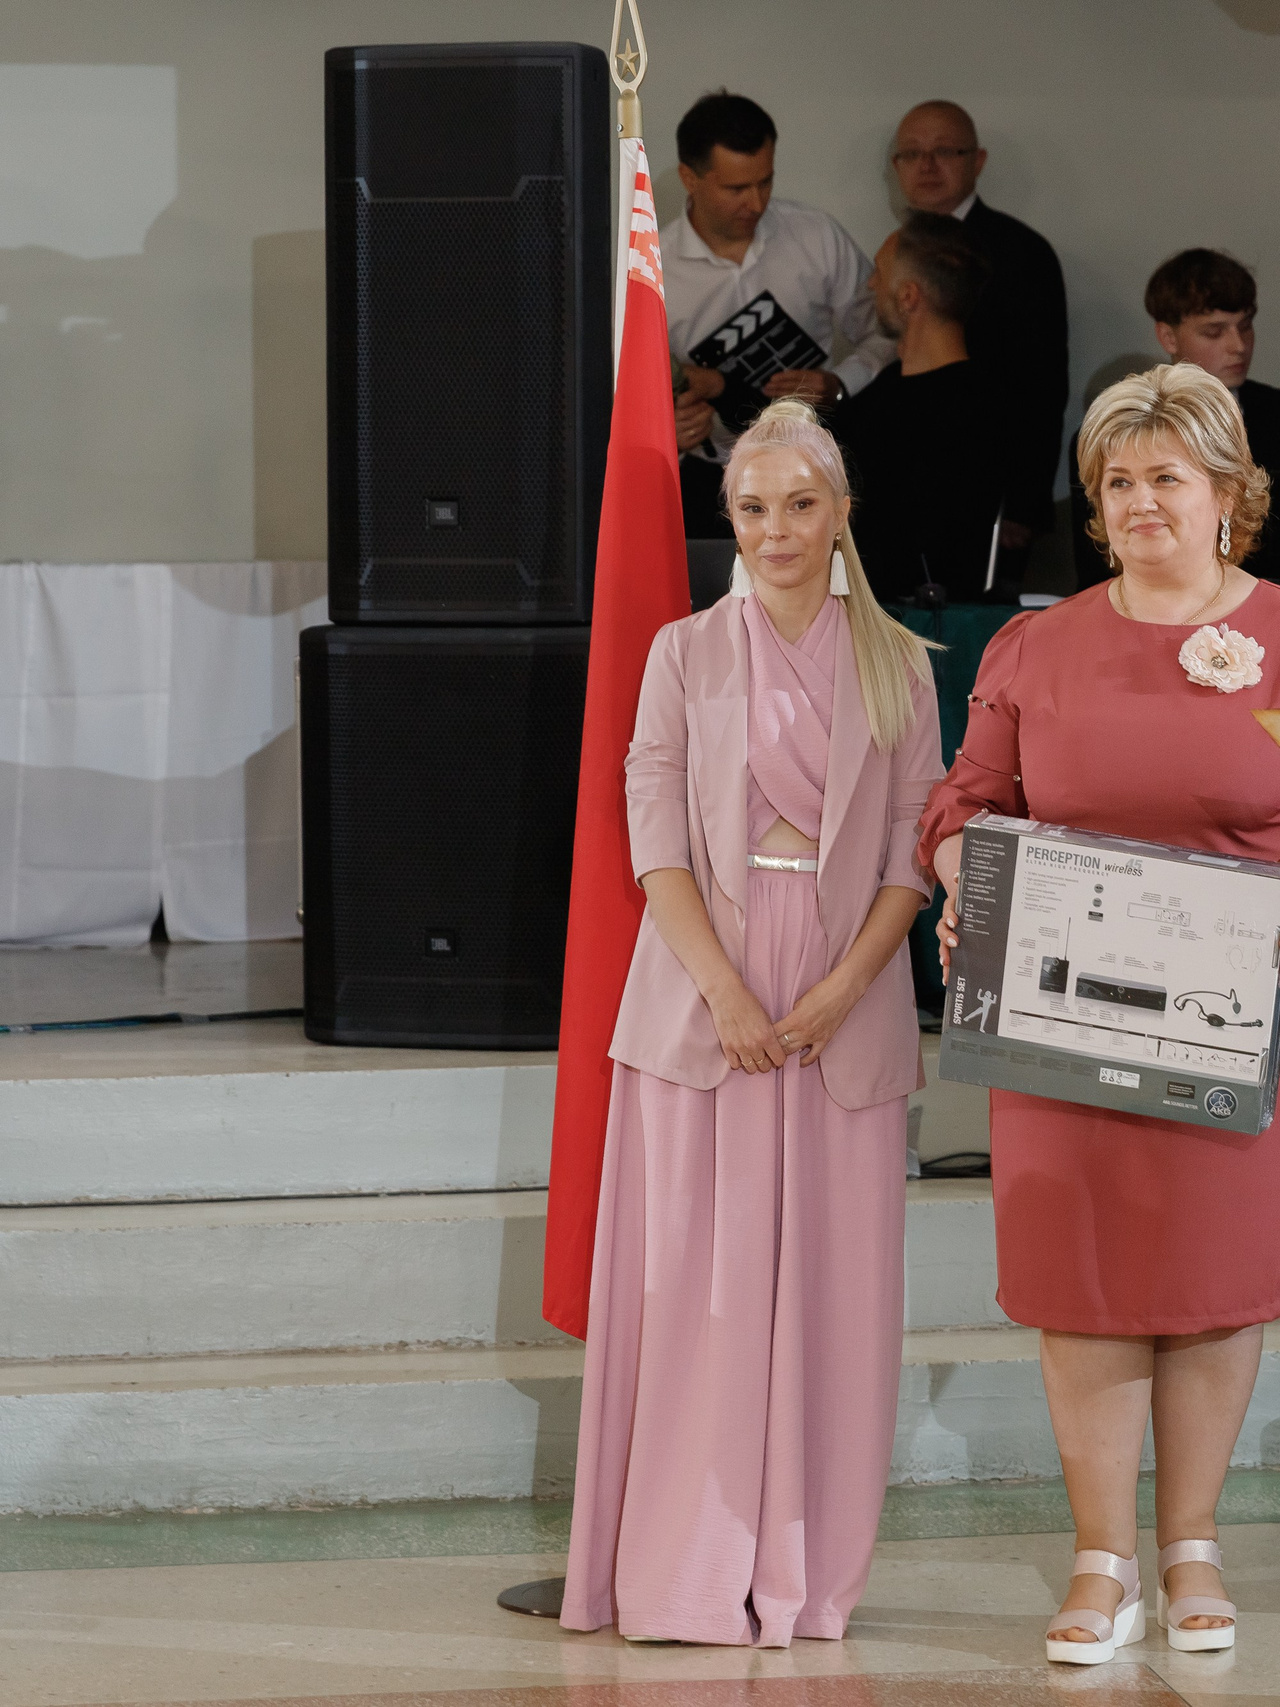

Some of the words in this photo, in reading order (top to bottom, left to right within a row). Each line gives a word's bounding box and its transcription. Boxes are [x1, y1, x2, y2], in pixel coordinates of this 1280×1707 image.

[435, 507, 454, 520] JBL
[1026, 845, 1101, 870] PERCEPTION
[1104, 862, 1144, 877] wireless
[431, 938, 451, 951] JBL
[956, 975, 966, 993] SET
[953, 992, 965, 1025] SPORTS
[1209, 1107, 1232, 1116] AKG
